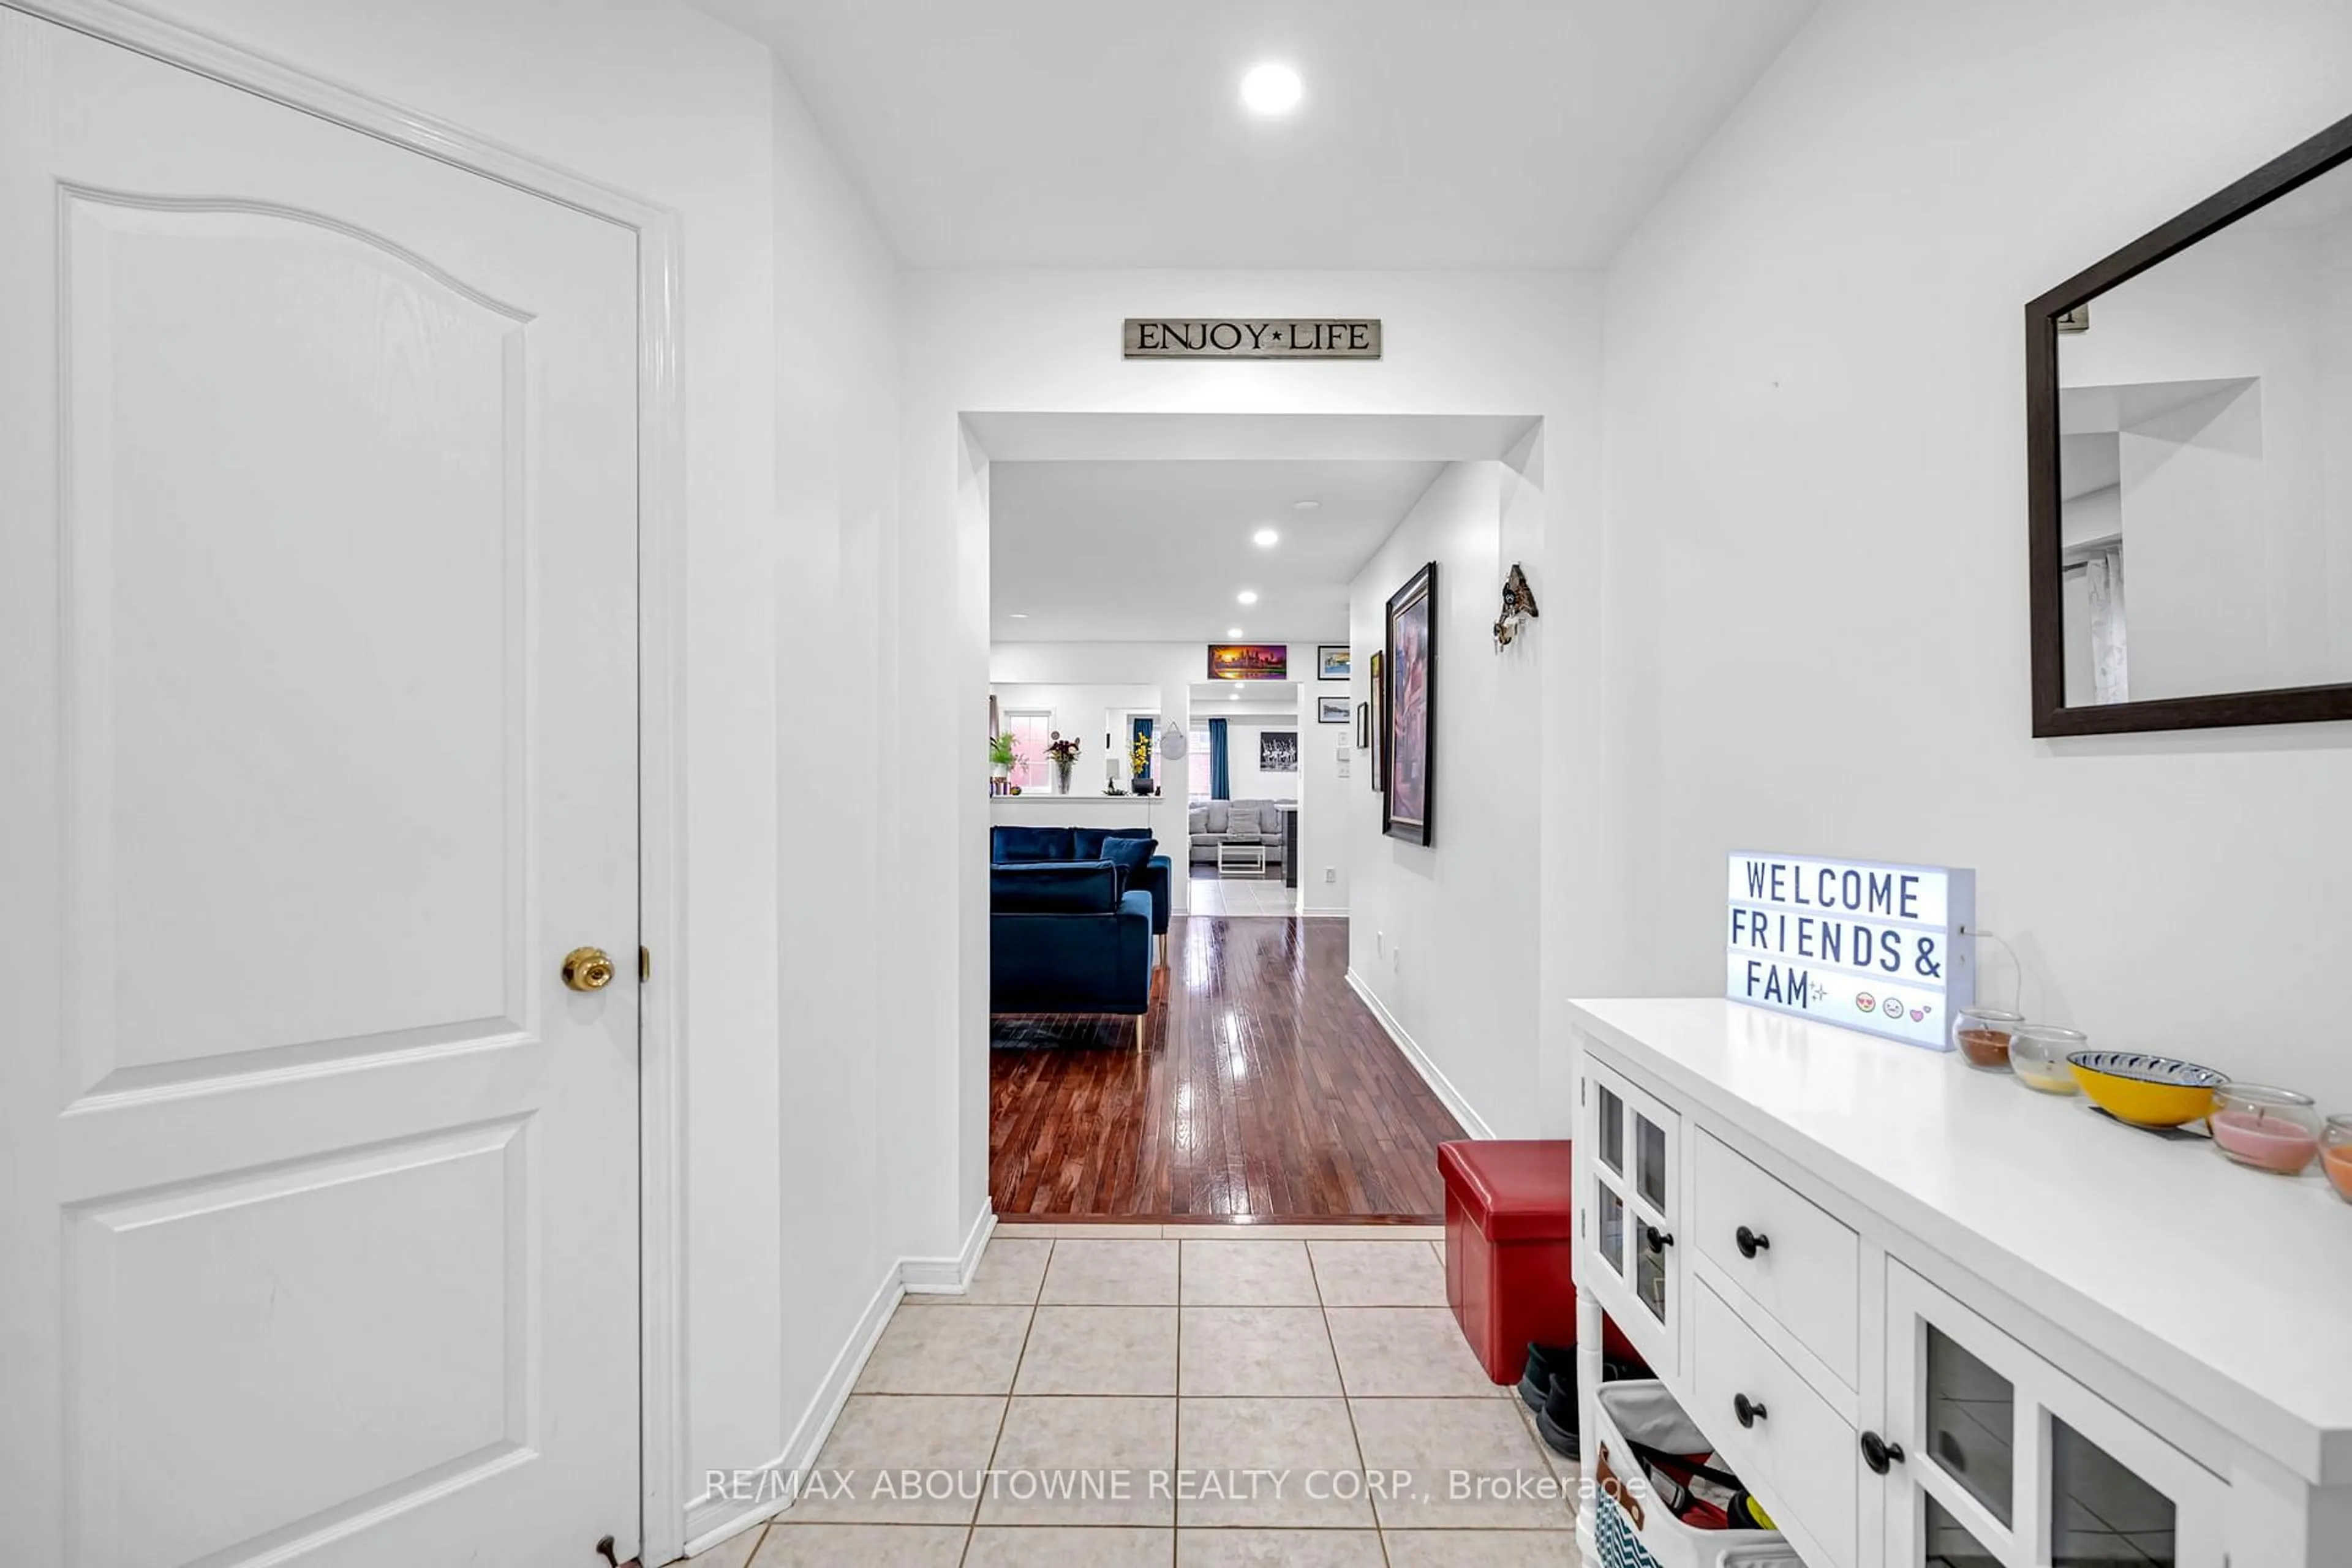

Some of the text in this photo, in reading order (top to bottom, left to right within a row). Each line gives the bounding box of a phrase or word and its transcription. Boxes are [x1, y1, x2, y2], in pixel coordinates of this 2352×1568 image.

[1138, 323, 1369, 350] ENJOY LIFE
[1747, 861, 1919, 919] WELCOME
[1733, 909, 1941, 978] FRIENDS &
[1747, 960, 1808, 1009] FAM
